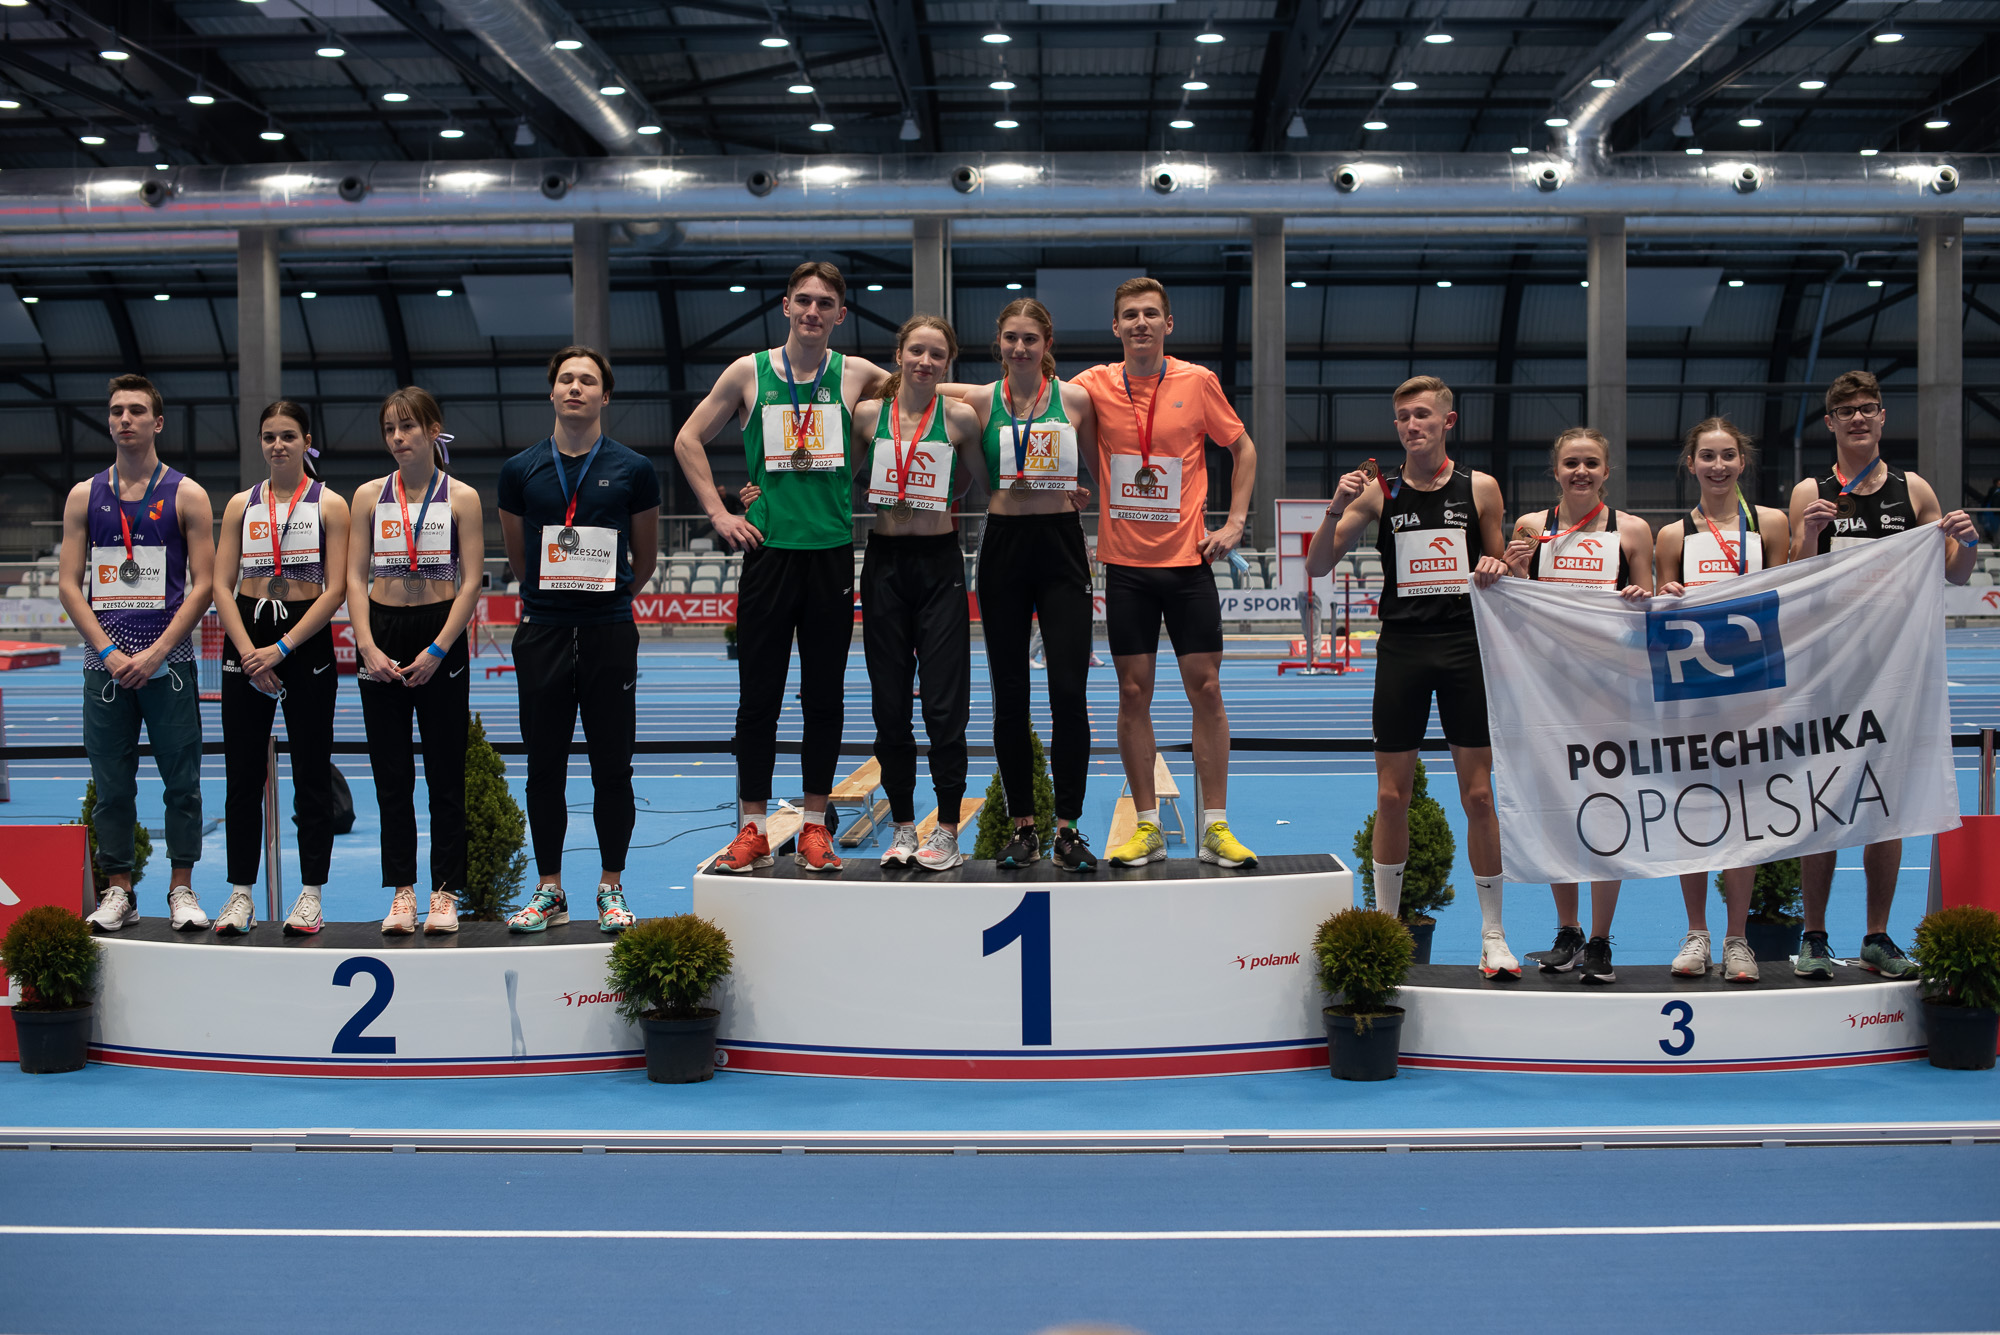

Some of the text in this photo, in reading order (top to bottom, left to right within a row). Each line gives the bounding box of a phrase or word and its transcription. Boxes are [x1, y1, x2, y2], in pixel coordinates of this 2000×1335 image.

[787, 437, 822, 449] PLA
[888, 470, 933, 486] OLEN
[880, 496, 915, 507] RZESW
[916, 501, 935, 509] 2022
[1117, 511, 1149, 520] RZESZÓW
[255, 555, 309, 566] RZESZW 2022
[421, 556, 440, 564] 2022
[1411, 559, 1455, 572] ORLEN
[1556, 558, 1600, 570] ORLEN
[551, 581, 604, 591] RZESZÓW 2022
[1408, 585, 1461, 595] RZESZÓW 2022
[102, 601, 135, 609] RZESZÓW
[1243, 597, 1299, 612] SPORT
[1566, 709, 1887, 780] POLITECHNIKA
[1576, 760, 1890, 857] OPOLSKA
[1250, 952, 1301, 970] polanik
[982, 891, 1053, 1046] 1
[331, 956, 397, 1055] 2
[577, 990, 626, 1007] polani
[1859, 1009, 1905, 1029] polanik
[1658, 1000, 1695, 1056] 3
